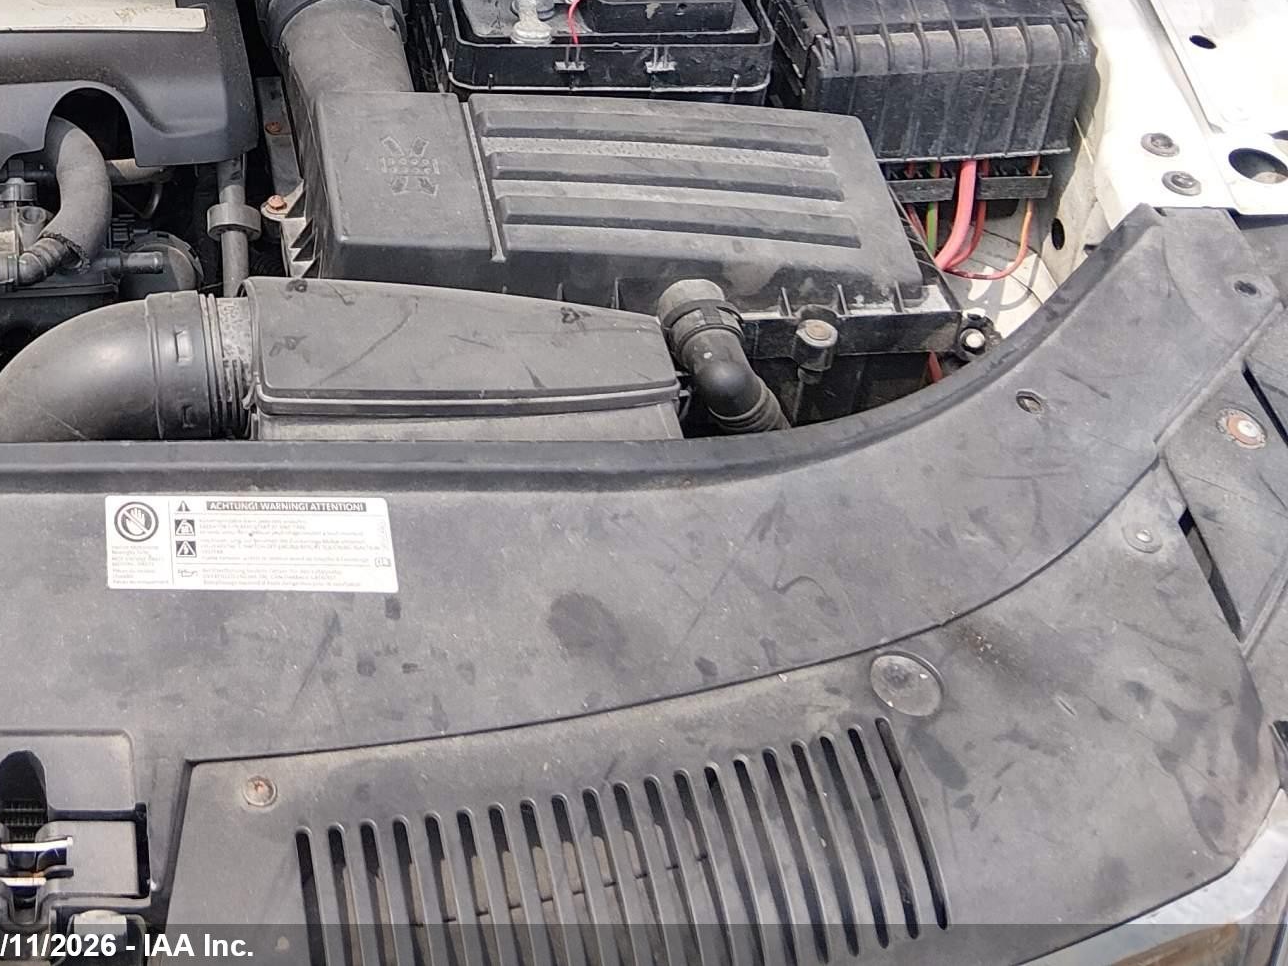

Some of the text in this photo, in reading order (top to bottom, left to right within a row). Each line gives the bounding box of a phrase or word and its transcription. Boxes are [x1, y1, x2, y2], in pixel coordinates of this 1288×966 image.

[210, 501, 365, 512] ACHTUNG! WARNING! ATTENTION!
